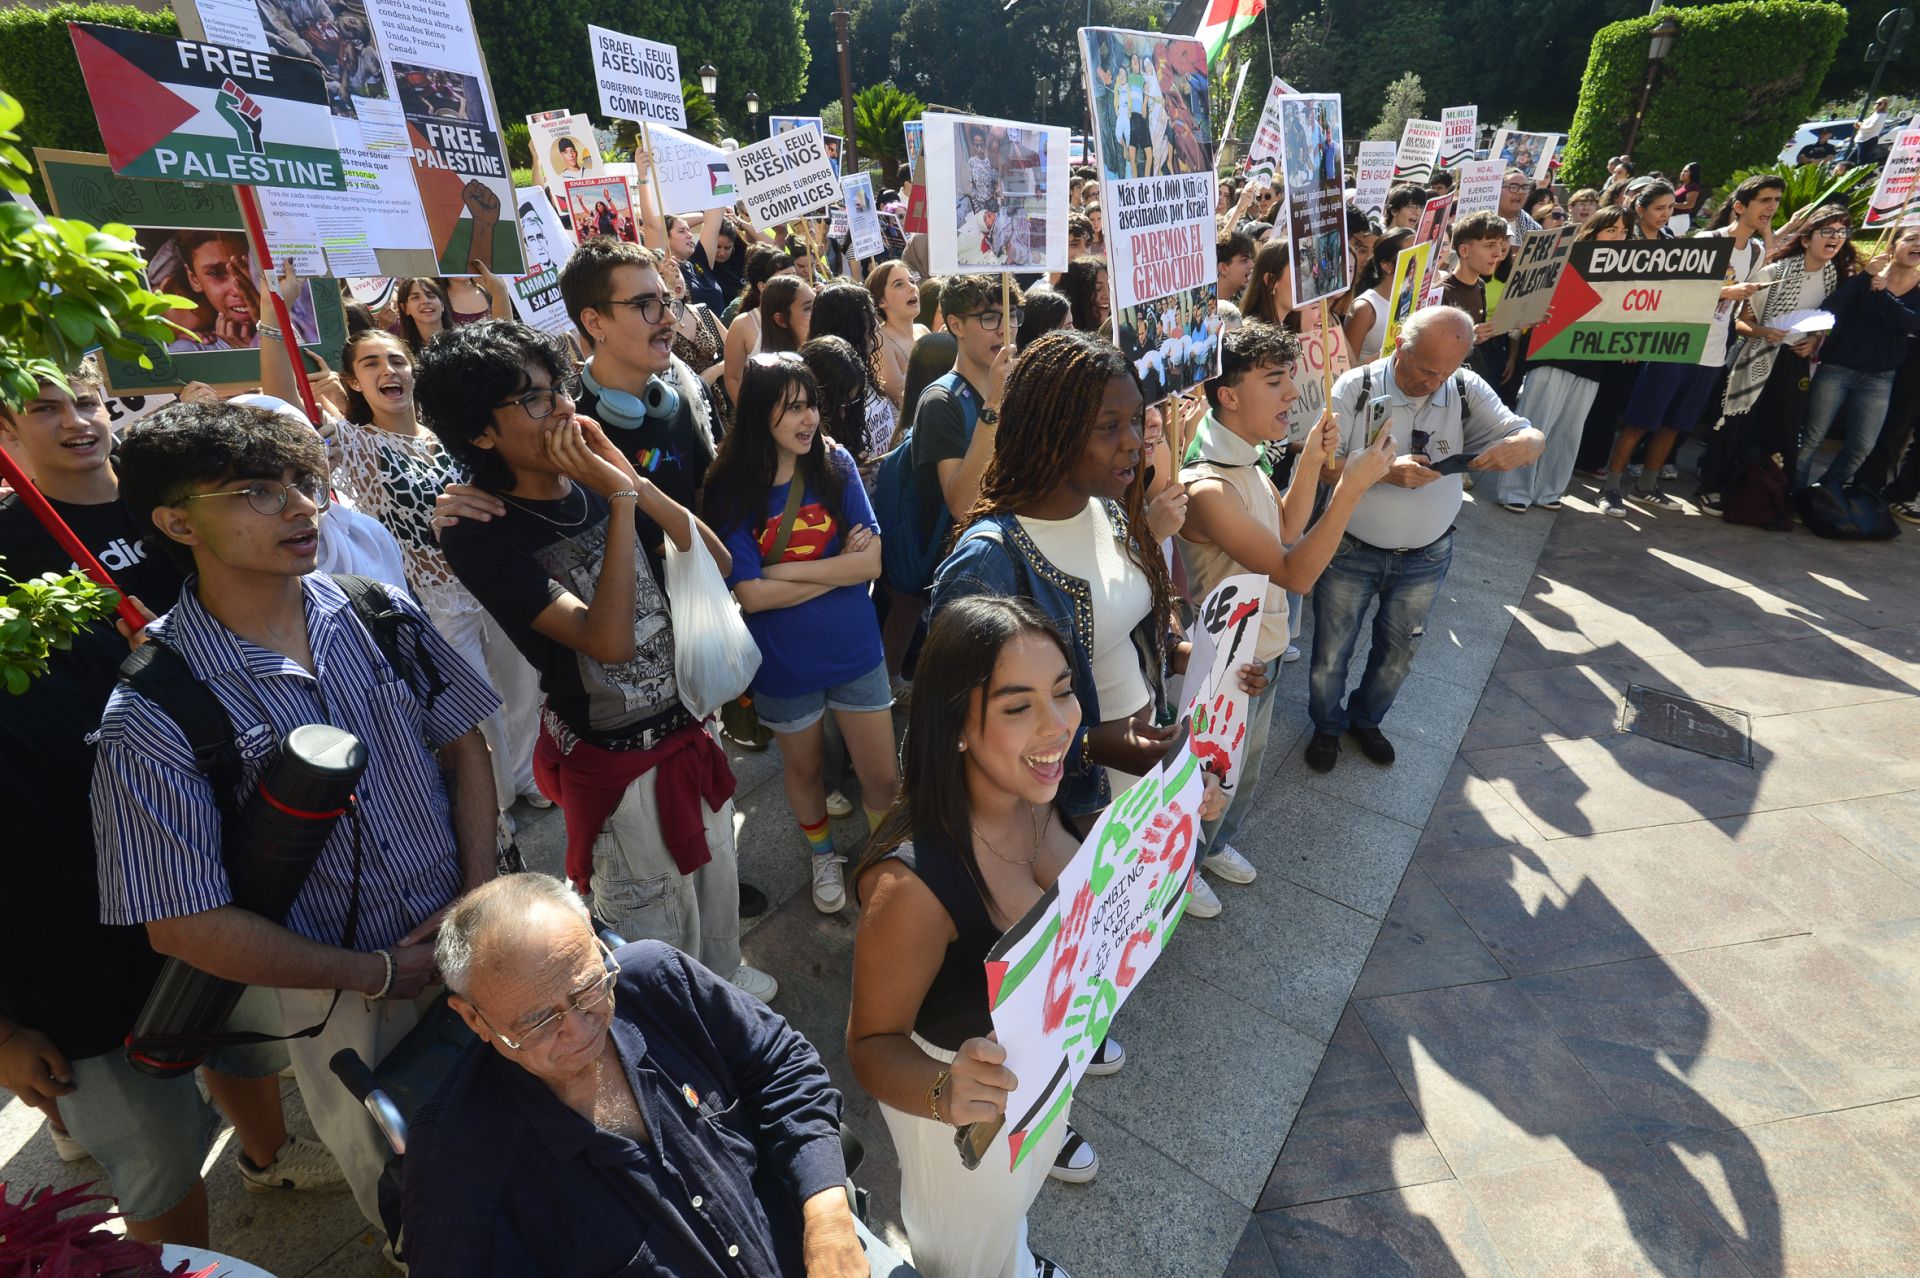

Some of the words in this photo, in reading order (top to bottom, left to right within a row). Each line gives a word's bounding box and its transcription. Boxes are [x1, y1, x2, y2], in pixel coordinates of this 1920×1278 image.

[378, 9, 411, 20] condena
[412, 14, 433, 25] hasta
[434, 21, 454, 30] ahora
[428, 8, 449, 19] fuerte
[381, 20, 396, 28] sus
[396, 23, 424, 34] aliados
[424, 28, 446, 39] Reino
[385, 31, 412, 43] Unido,
[412, 36, 439, 47] Francia
[176, 41, 274, 82] FREE
[388, 43, 418, 55] Canadá
[598, 35, 636, 56] ISRAEL
[645, 47, 672, 65] EEUU
[601, 51, 676, 82] ASESINOS
[600, 79, 643, 96] GOBIERNOS
[644, 88, 681, 103] EUROPEOS
[609, 92, 680, 122] CÓMPLICES
[1446, 110, 1474, 119] MURCIA
[425, 123, 486, 153] FREE
[1445, 125, 1473, 137] LIBRE
[413, 147, 502, 175] PALESTINE
[736, 146, 776, 169] ISRAEL
[784, 131, 814, 151] EEUU
[744, 144, 822, 186] ASESINOS
[155, 148, 337, 187] PALESTINE
[351, 160, 373, 169] revela
[373, 163, 389, 171] que
[1361, 169, 1372, 180] EN
[1476, 166, 1486, 174] NO
[747, 183, 793, 207] GOBIERNOS
[792, 168, 832, 190] EUROPEOS
[760, 182, 834, 221] CÓMPLICES
[1117, 182, 1136, 208] Más
[1138, 182, 1150, 205] de
[1152, 179, 1181, 204] 16.000
[1183, 176, 1209, 200] Niñ@s
[1119, 205, 1168, 230] asesinados
[1169, 203, 1184, 225] por
[1186, 197, 1209, 220] Israel
[1131, 226, 1189, 267] PAREMOS
[1189, 223, 1204, 254] EL
[1519, 233, 1557, 266] FREE
[1588, 248, 1717, 274] EDUCACION
[519, 270, 557, 297] AHMAD
[1132, 252, 1205, 302] GENOCIDIO
[1504, 261, 1561, 300] PALESTINE
[1622, 289, 1662, 312] CON
[1569, 330, 1691, 356] PALESTINA
[1202, 586, 1238, 635] EE
[1092, 858, 1144, 935] BOMBING
[1103, 896, 1130, 936] KIDS
[1111, 910, 1130, 938] NOT
[1115, 897, 1157, 949] DEFENSE
